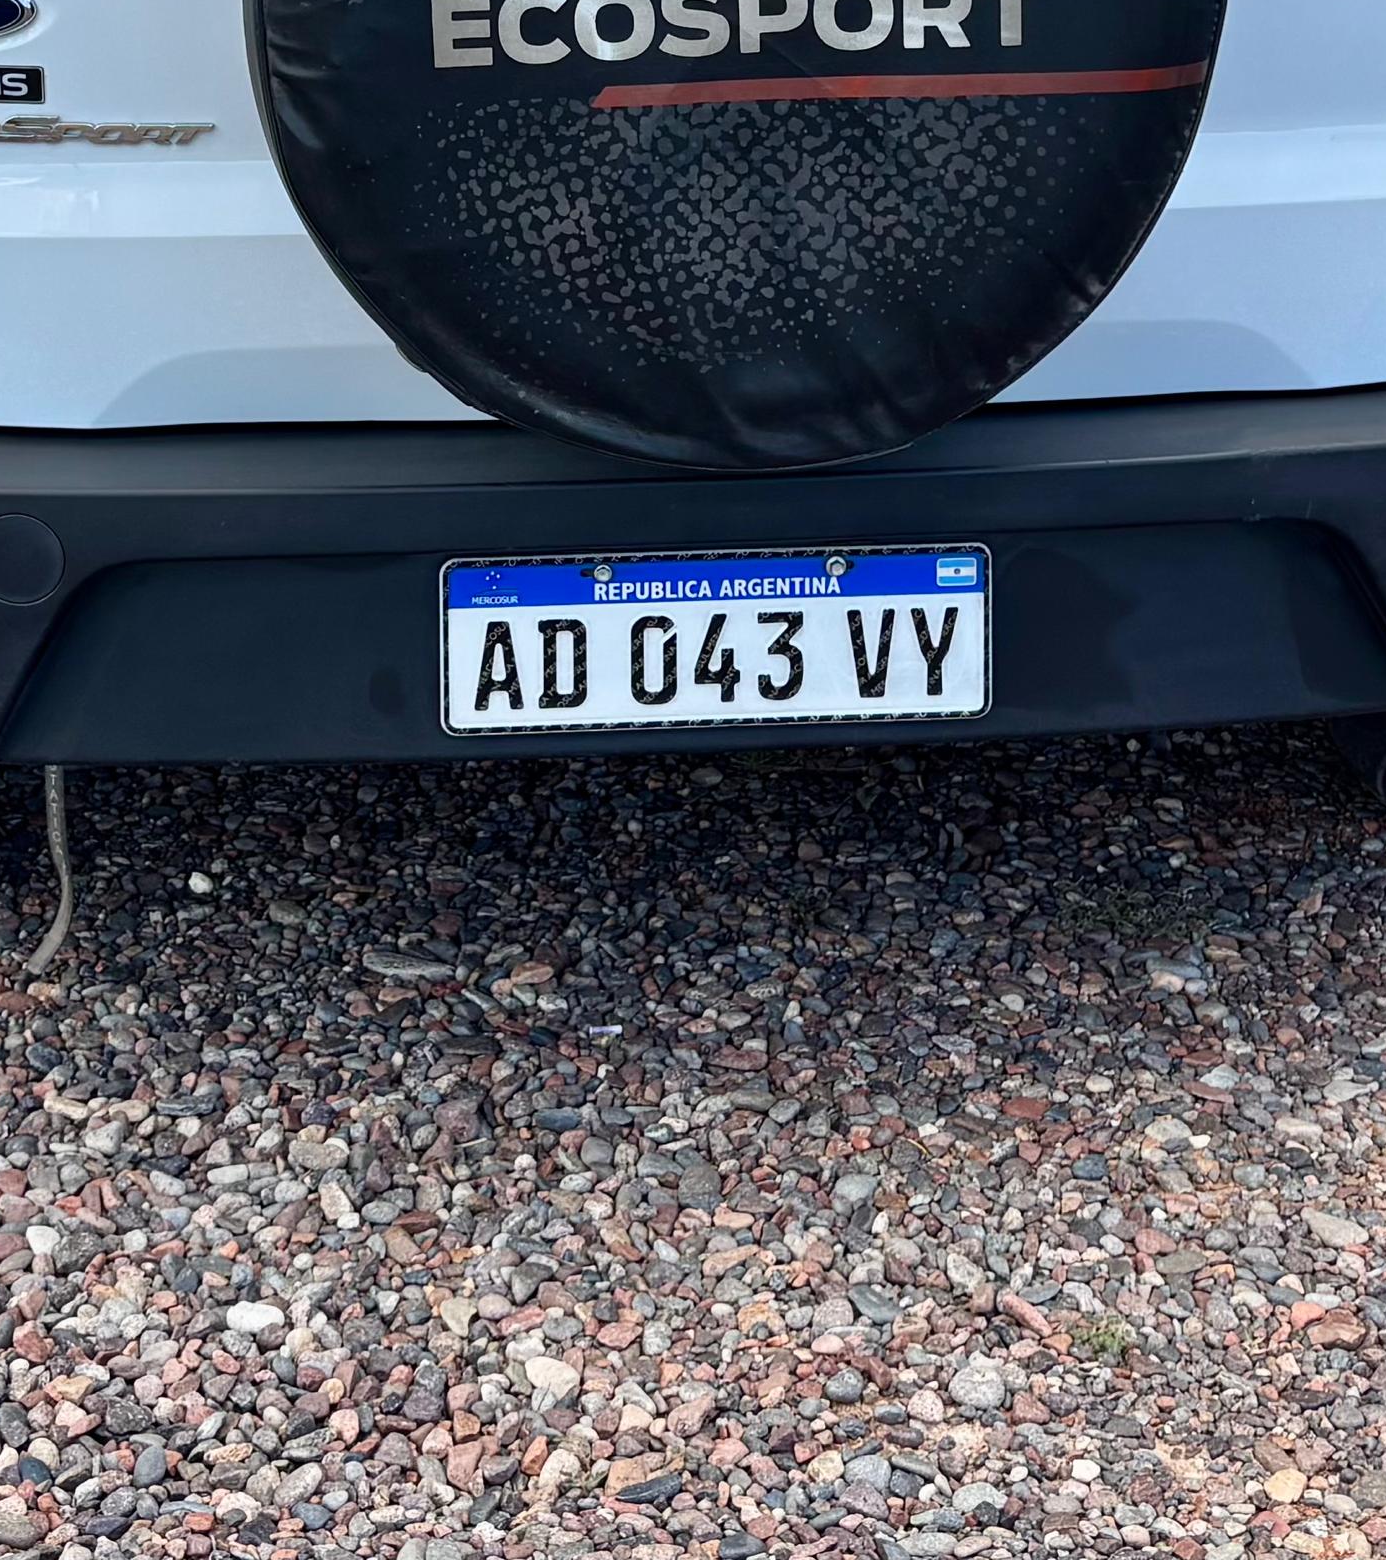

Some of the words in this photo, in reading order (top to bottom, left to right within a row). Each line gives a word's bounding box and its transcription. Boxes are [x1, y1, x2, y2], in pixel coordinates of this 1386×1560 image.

[471, 594, 519, 605] MERCOSUR
[593, 578, 712, 602] REPUBLICA
[718, 576, 842, 599] ARGENTINA
[473, 618, 589, 712] AD
[629, 610, 805, 706] 043
[845, 606, 960, 699] VY
